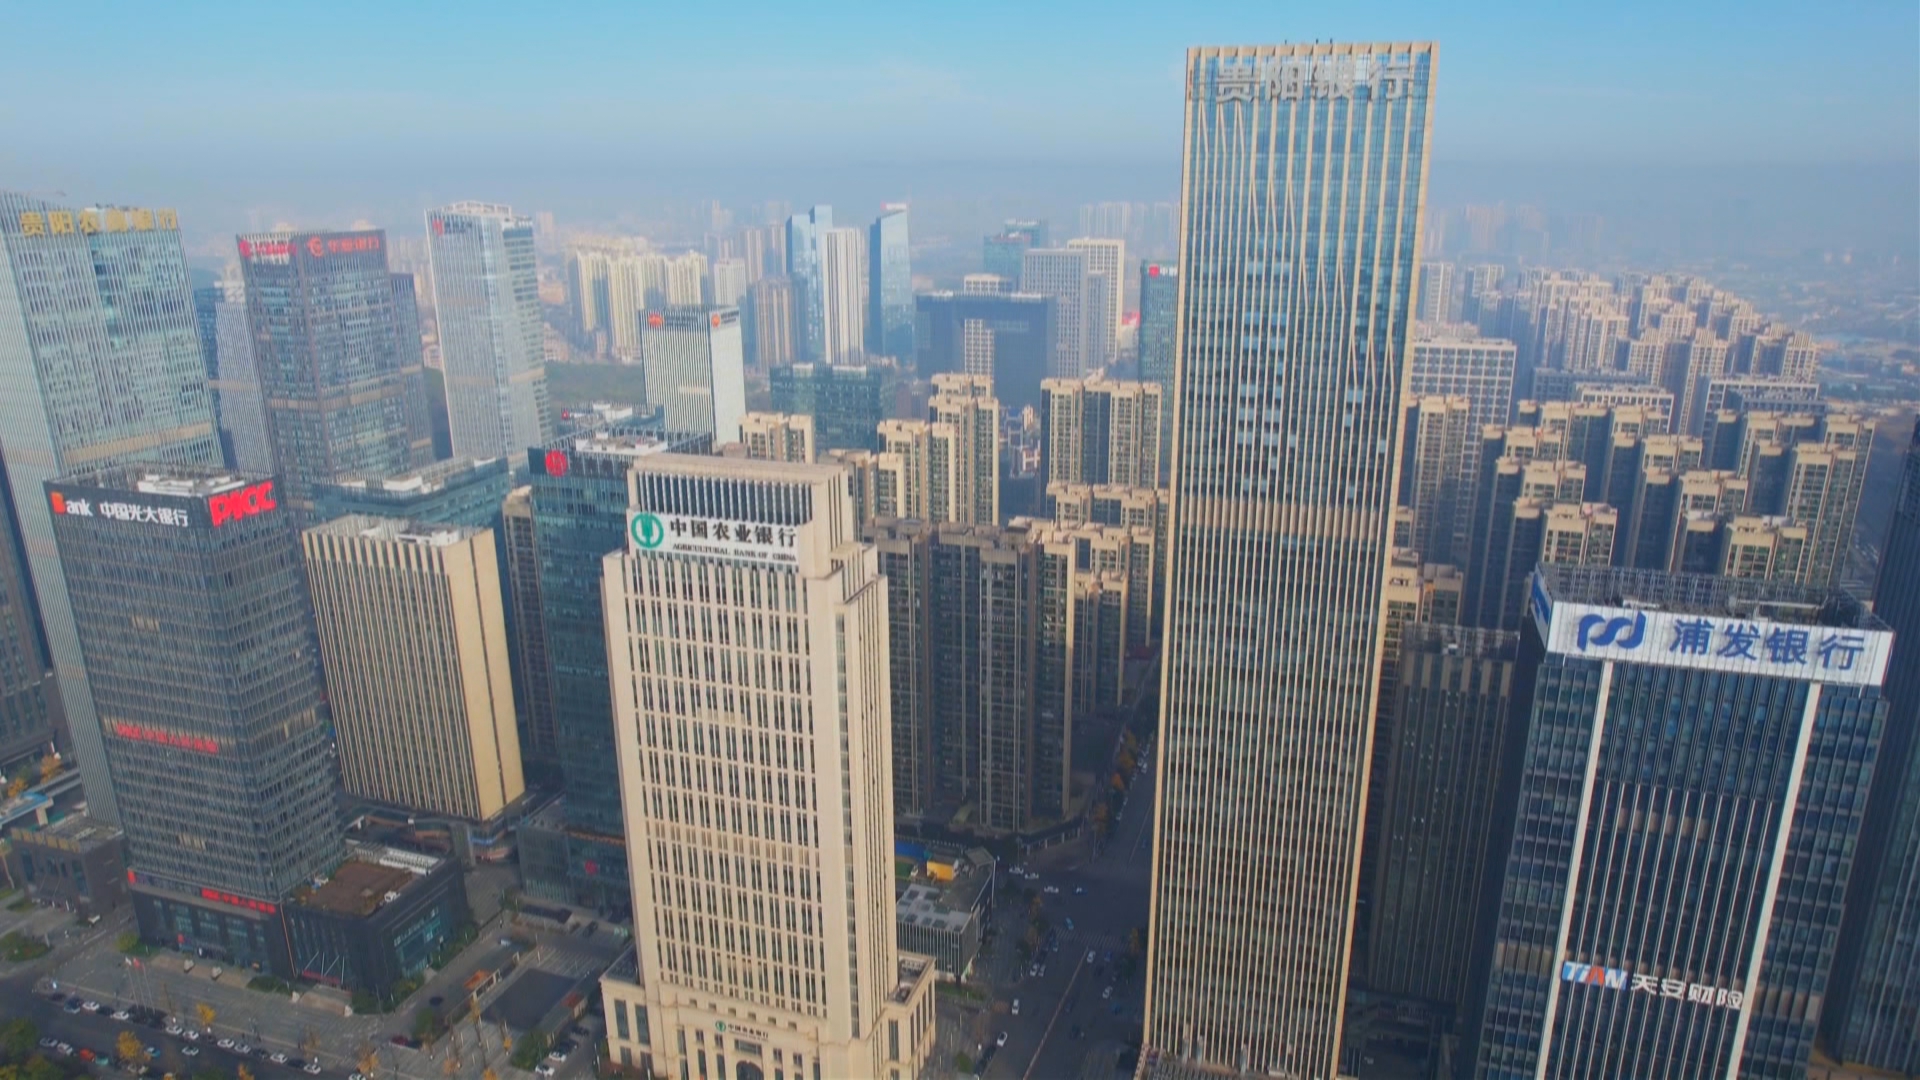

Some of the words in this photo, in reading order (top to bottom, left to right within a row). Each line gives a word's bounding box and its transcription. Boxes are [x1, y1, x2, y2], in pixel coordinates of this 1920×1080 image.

[1215, 61, 1413, 103] 贵阳银行
[51, 491, 93, 517] Bank
[100, 502, 188, 527] 中国光大银行
[208, 481, 276, 527] PICC
[670, 518, 797, 547] 中国农业银行
[673, 543, 729, 555] AGRICULTURAL
[734, 550, 756, 558] BANK
[772, 553, 797, 562] CHINA
[1669, 618, 1865, 671] 浦发银行
[1631, 974, 1743, 1009] 天安财险
